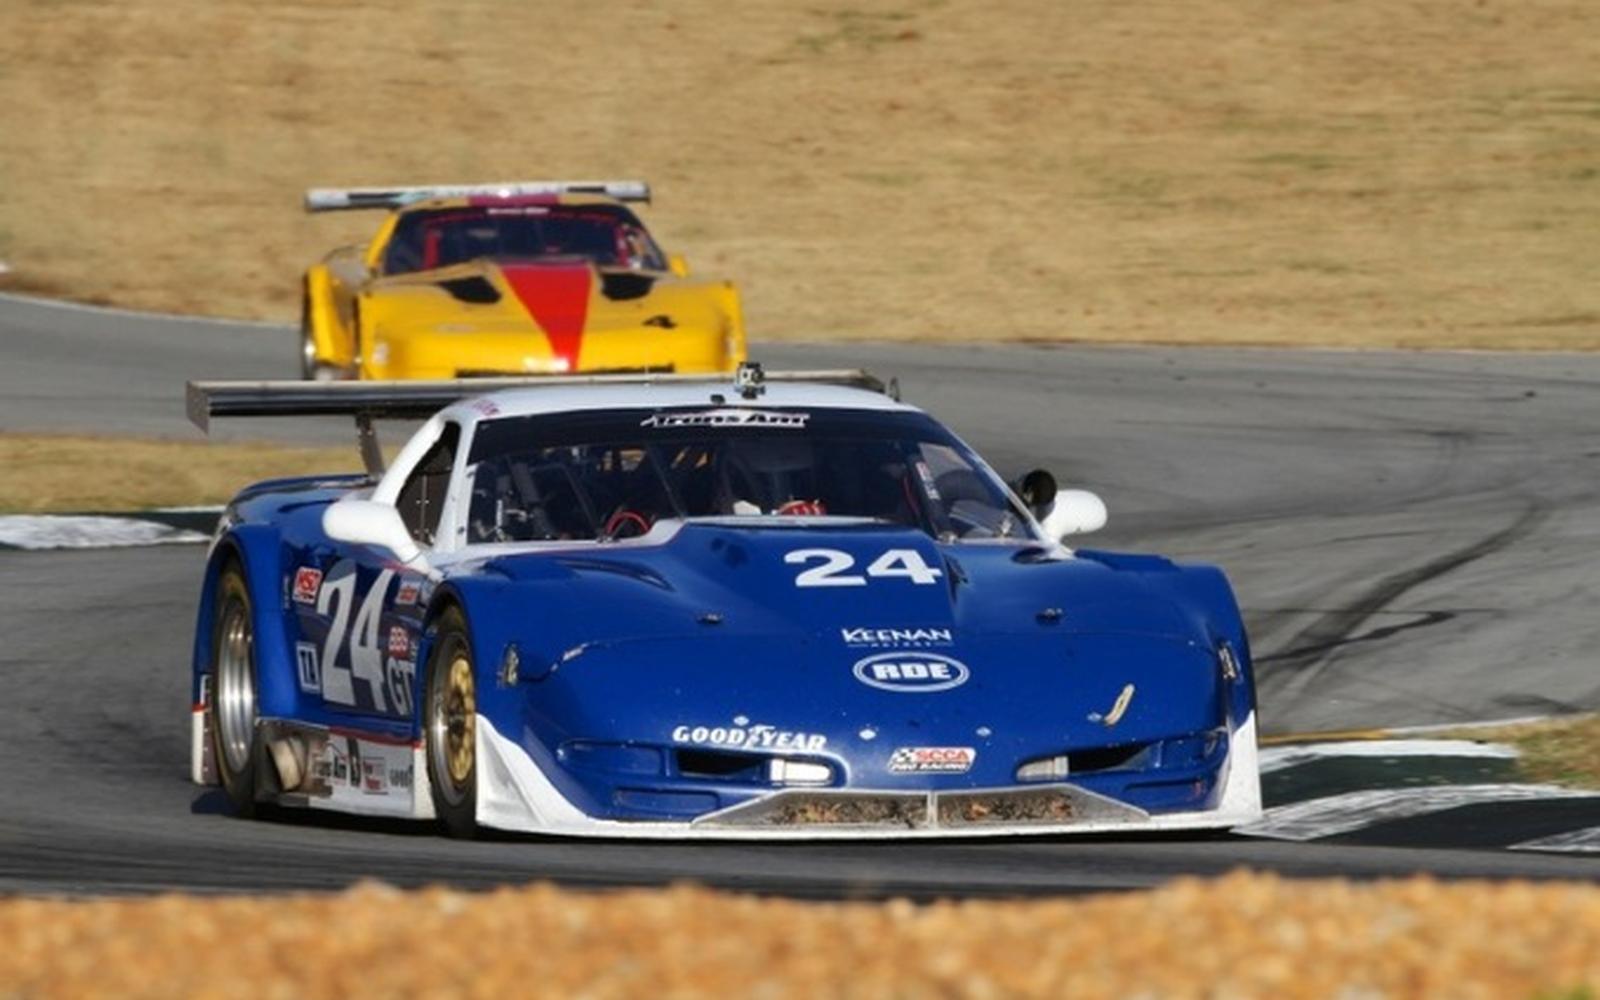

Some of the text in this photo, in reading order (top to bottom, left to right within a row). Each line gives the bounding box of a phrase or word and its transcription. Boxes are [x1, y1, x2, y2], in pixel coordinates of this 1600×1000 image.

[784, 548, 943, 587] 24
[317, 559, 395, 713] 24
[841, 627, 952, 642] KEENAN
[872, 663, 952, 679] RDE
[671, 724, 828, 750] GOODYEAR
[914, 749, 970, 763] SCCA
